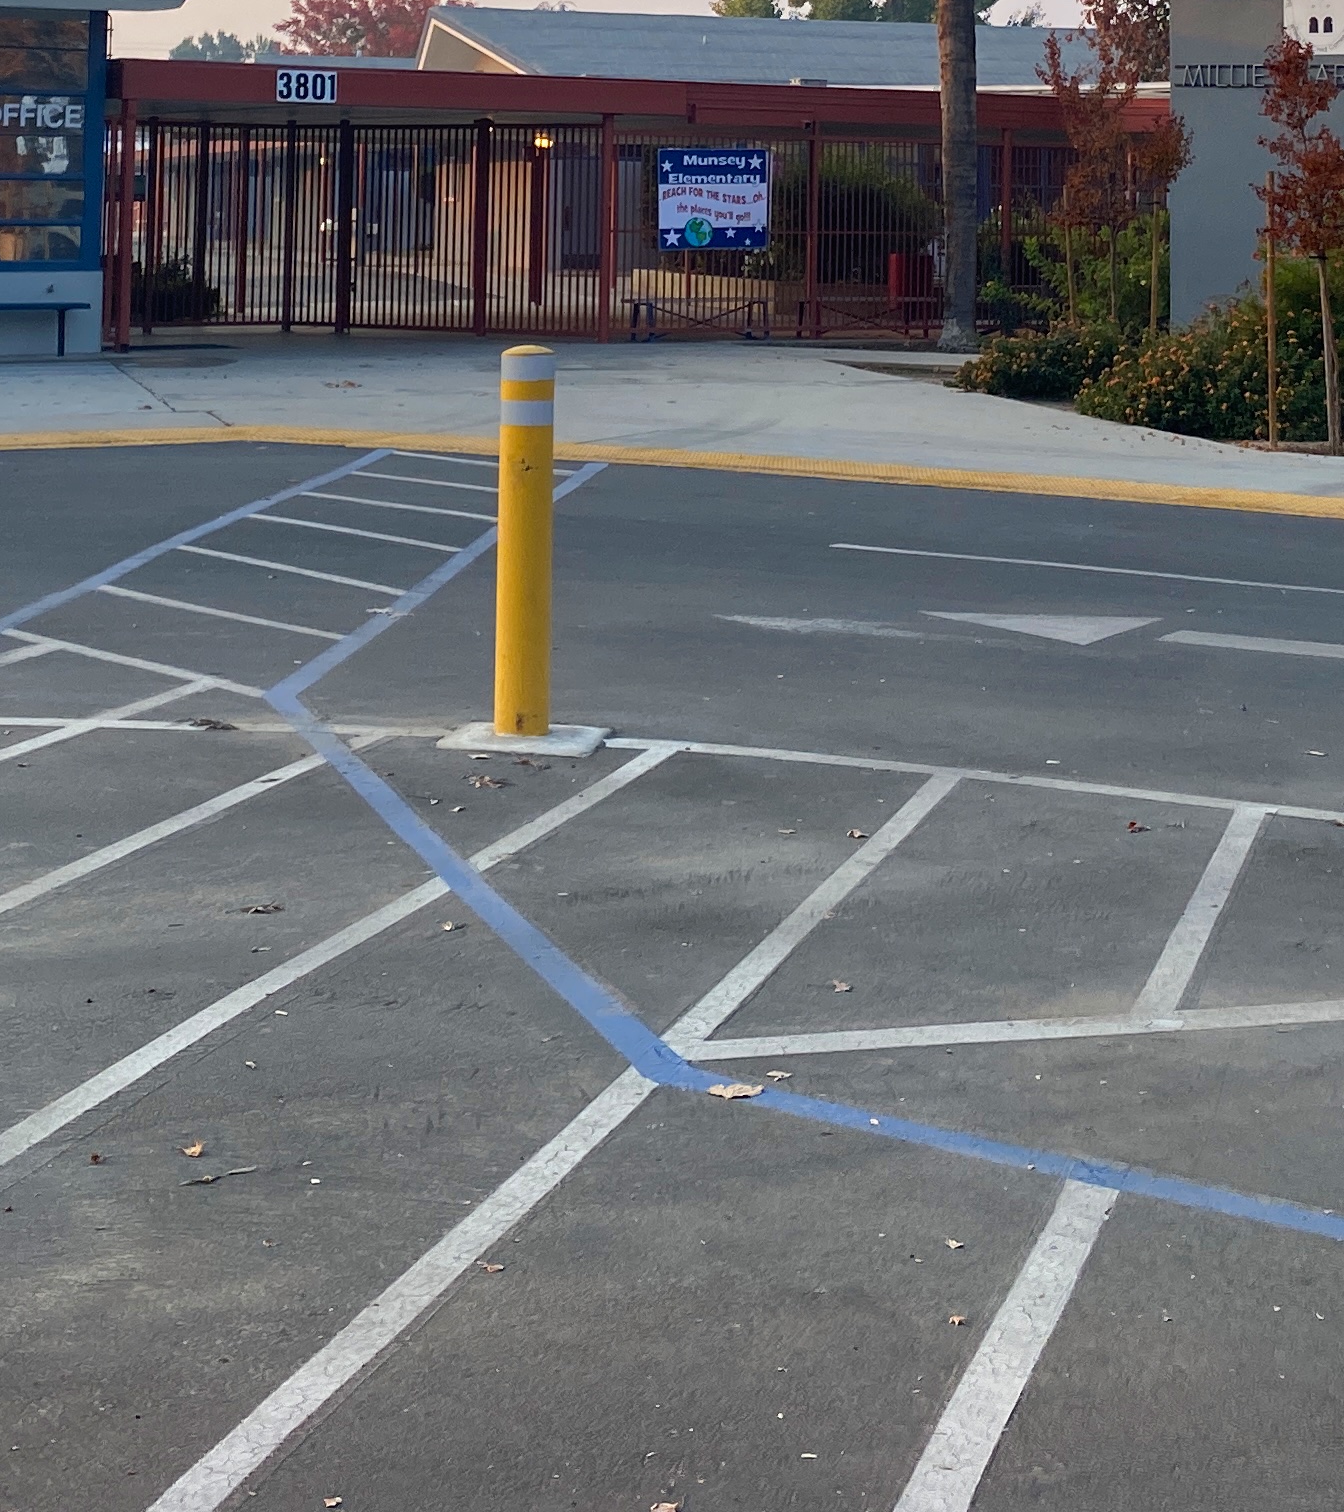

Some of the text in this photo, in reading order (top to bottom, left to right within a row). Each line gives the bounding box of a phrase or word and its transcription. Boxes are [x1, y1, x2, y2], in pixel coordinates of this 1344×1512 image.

[1181, 63, 1265, 87] MILLIE
[278, 72, 336, 100] 3801
[683, 155, 746, 170] Munsey
[668, 173, 761, 187] Elementary
[662, 186, 687, 200] REACH
[688, 187, 703, 197] FOR
[706, 190, 719, 201] THE
